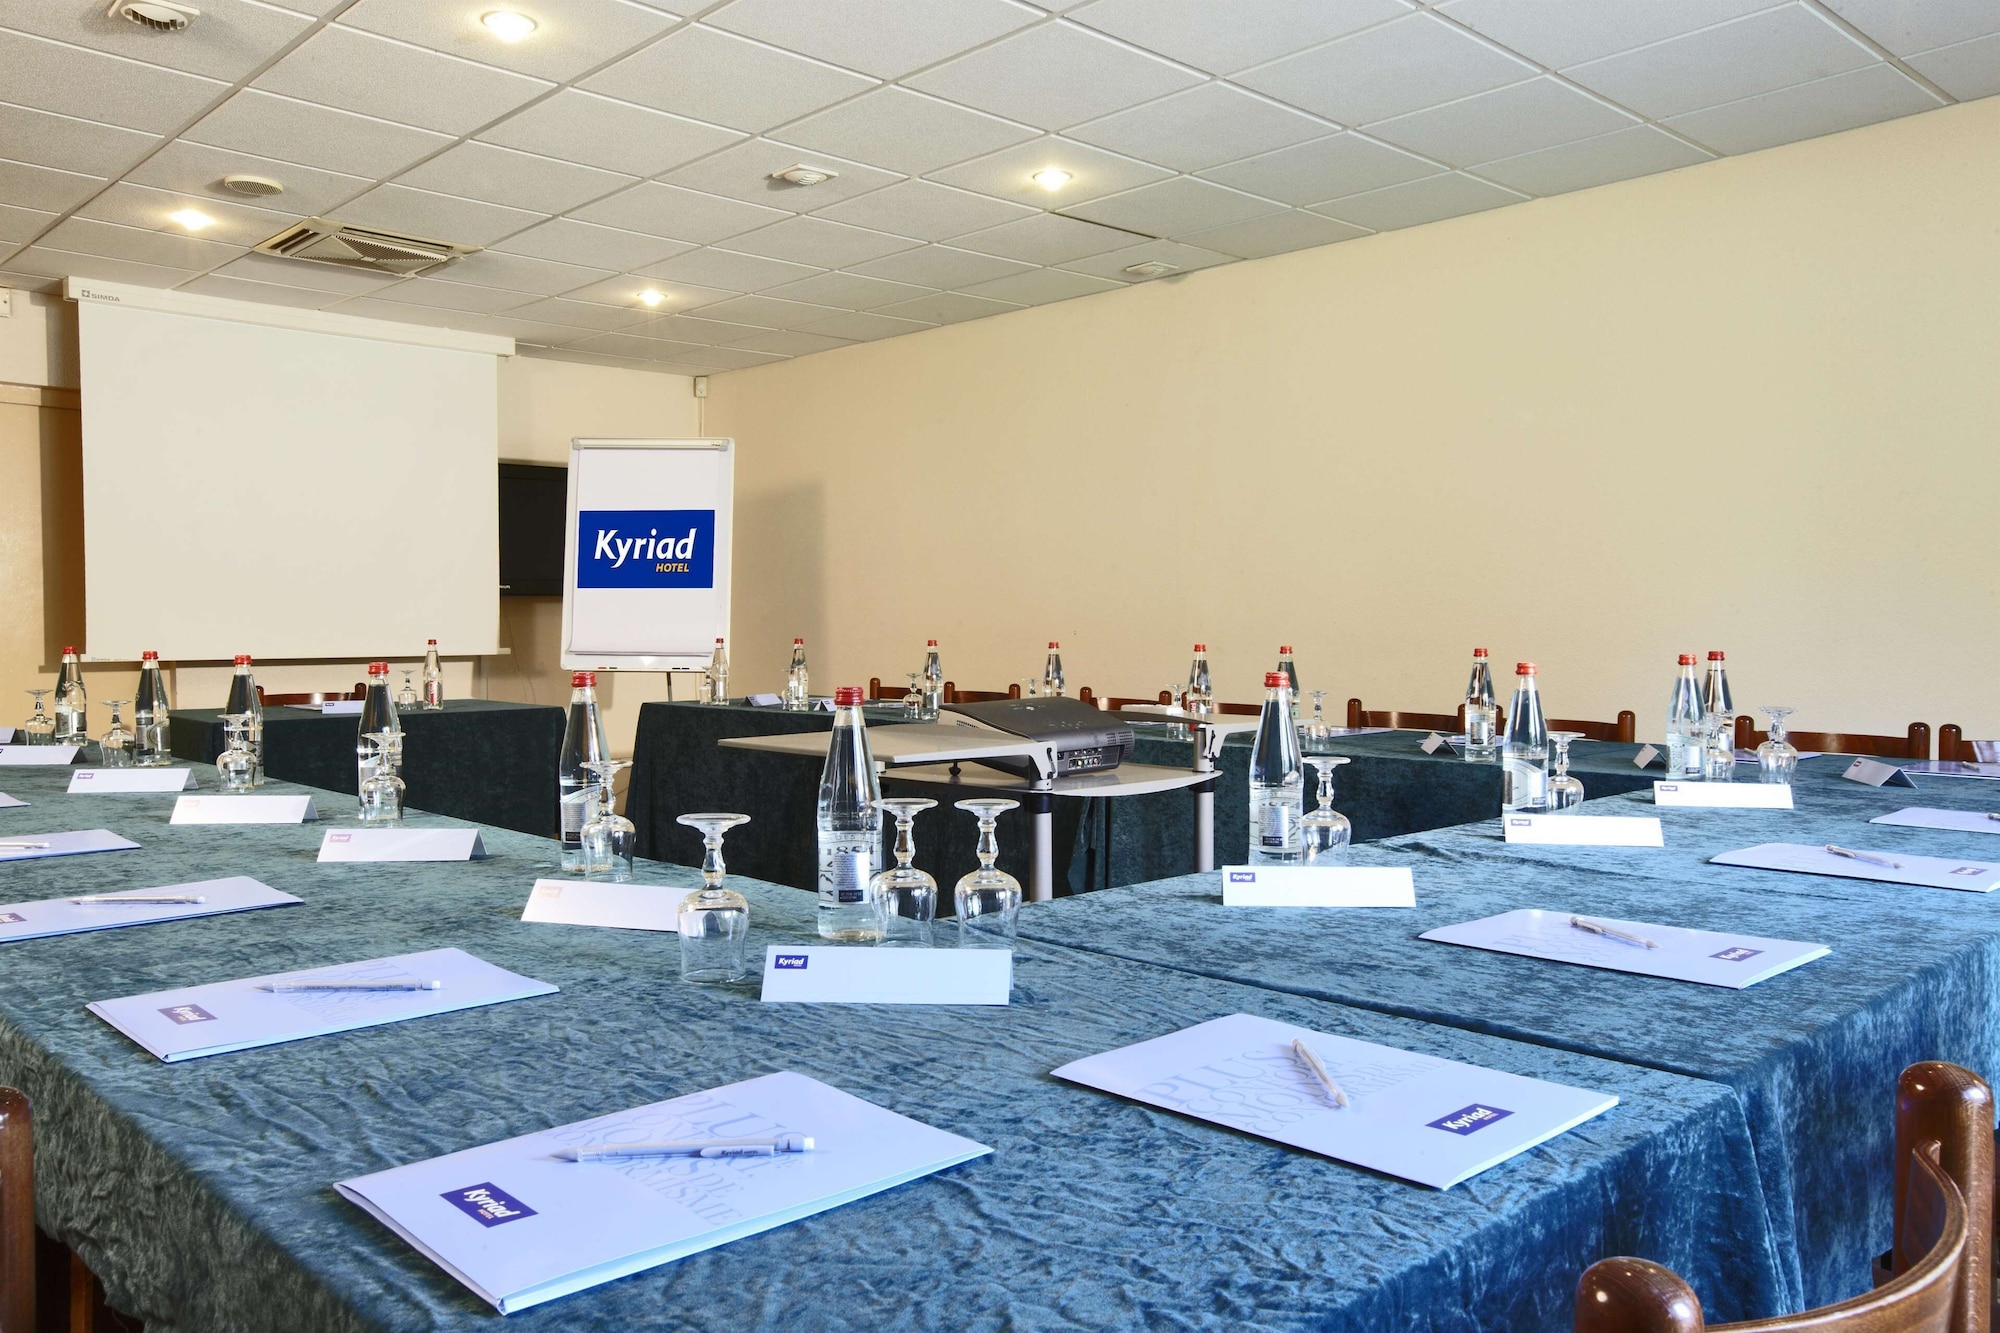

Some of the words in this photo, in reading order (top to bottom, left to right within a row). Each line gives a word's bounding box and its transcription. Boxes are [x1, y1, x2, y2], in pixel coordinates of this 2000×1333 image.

[91, 293, 120, 302] SIMDA
[594, 528, 697, 569] Kyriad
[655, 563, 690, 573] HOTEL
[778, 957, 805, 967] Kyriad
[1442, 1107, 1493, 1130] Kyriad
[463, 1188, 521, 1218] Kyriad
